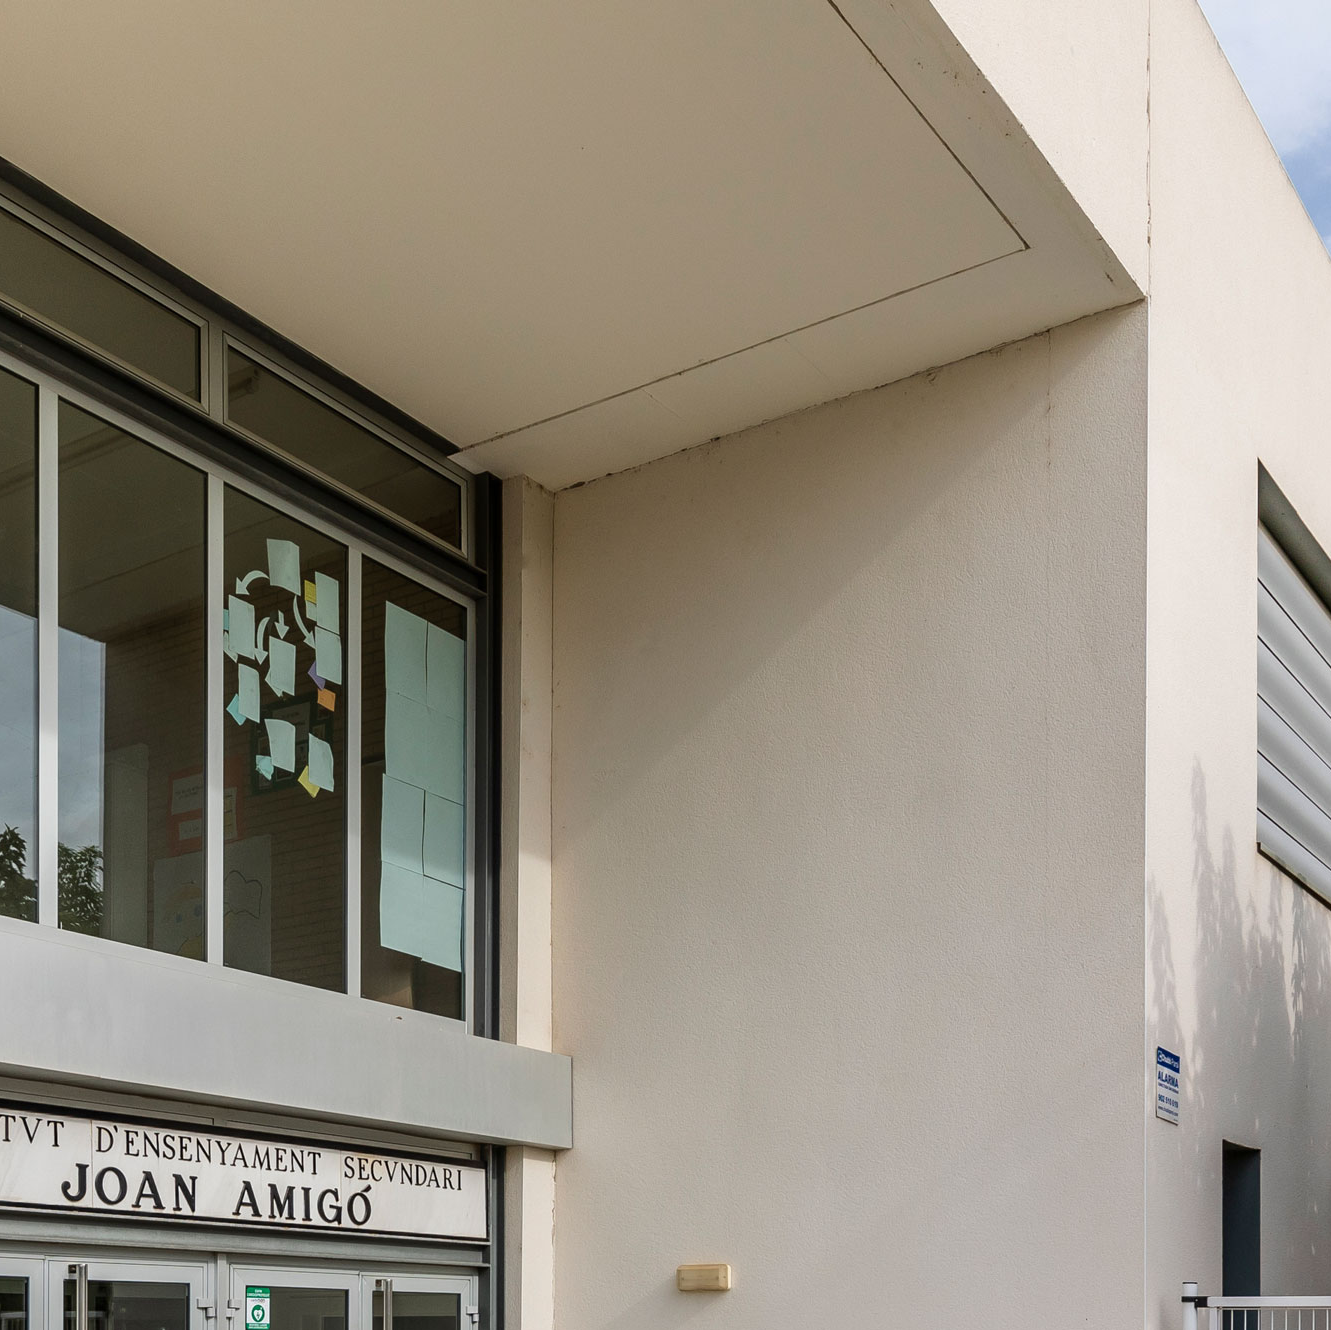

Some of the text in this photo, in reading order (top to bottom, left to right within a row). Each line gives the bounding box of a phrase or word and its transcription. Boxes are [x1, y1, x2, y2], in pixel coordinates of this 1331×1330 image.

[1158, 1071, 1178, 1088] ALARMA
[95, 1125, 322, 1176] D'ENSENYAMENT
[343, 1155, 463, 1191] SECVNDARI
[61, 1163, 374, 1226] JOAN AMIGÓ
